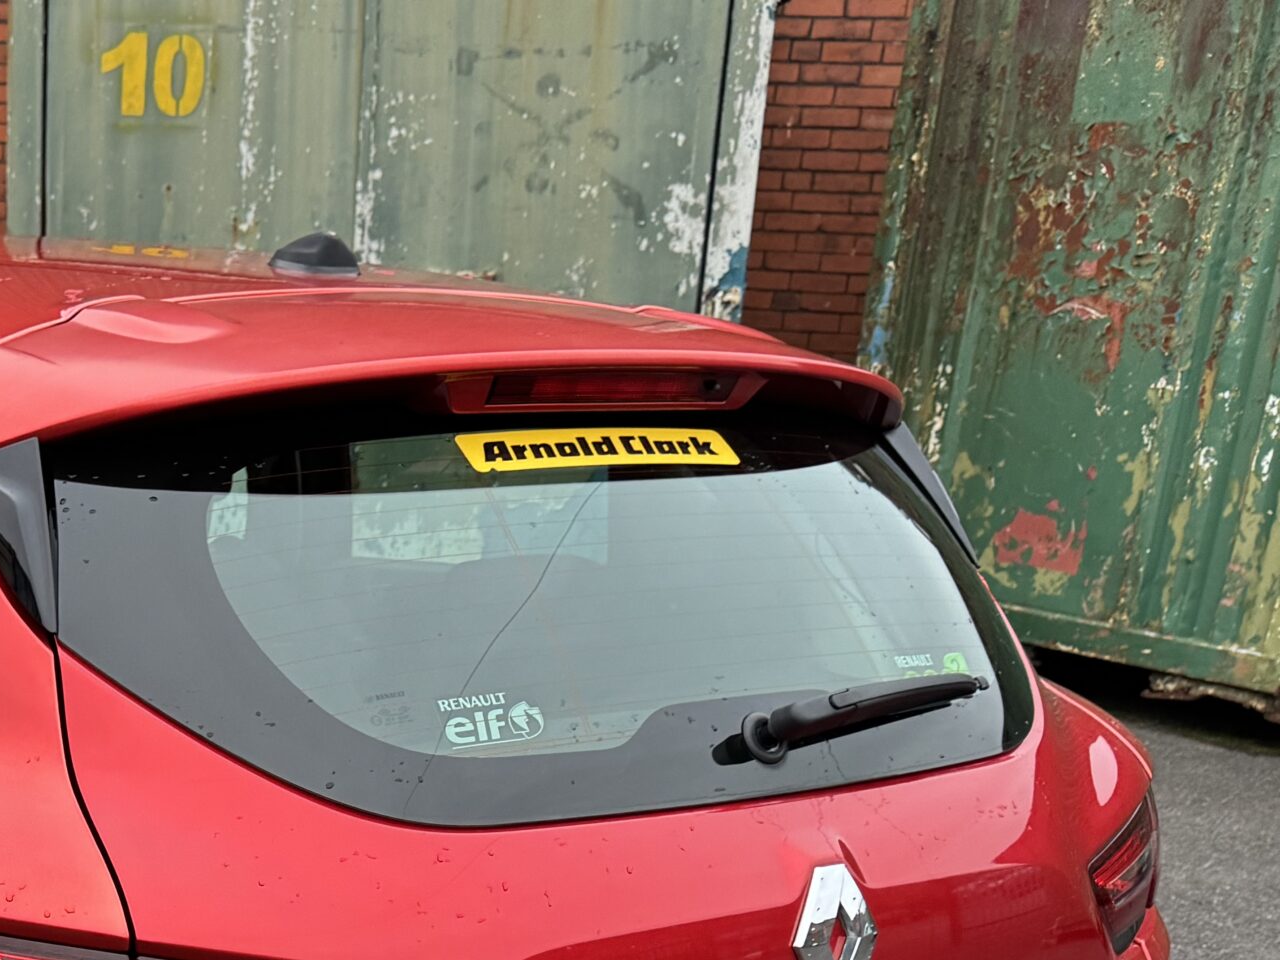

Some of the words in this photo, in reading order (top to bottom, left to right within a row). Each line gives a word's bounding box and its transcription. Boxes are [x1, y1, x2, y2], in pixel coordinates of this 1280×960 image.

[101, 32, 205, 117] 10
[483, 436, 616, 462] Arnold
[619, 434, 719, 456] Clark
[437, 692, 506, 712] RENAULT
[445, 708, 506, 744] elf
